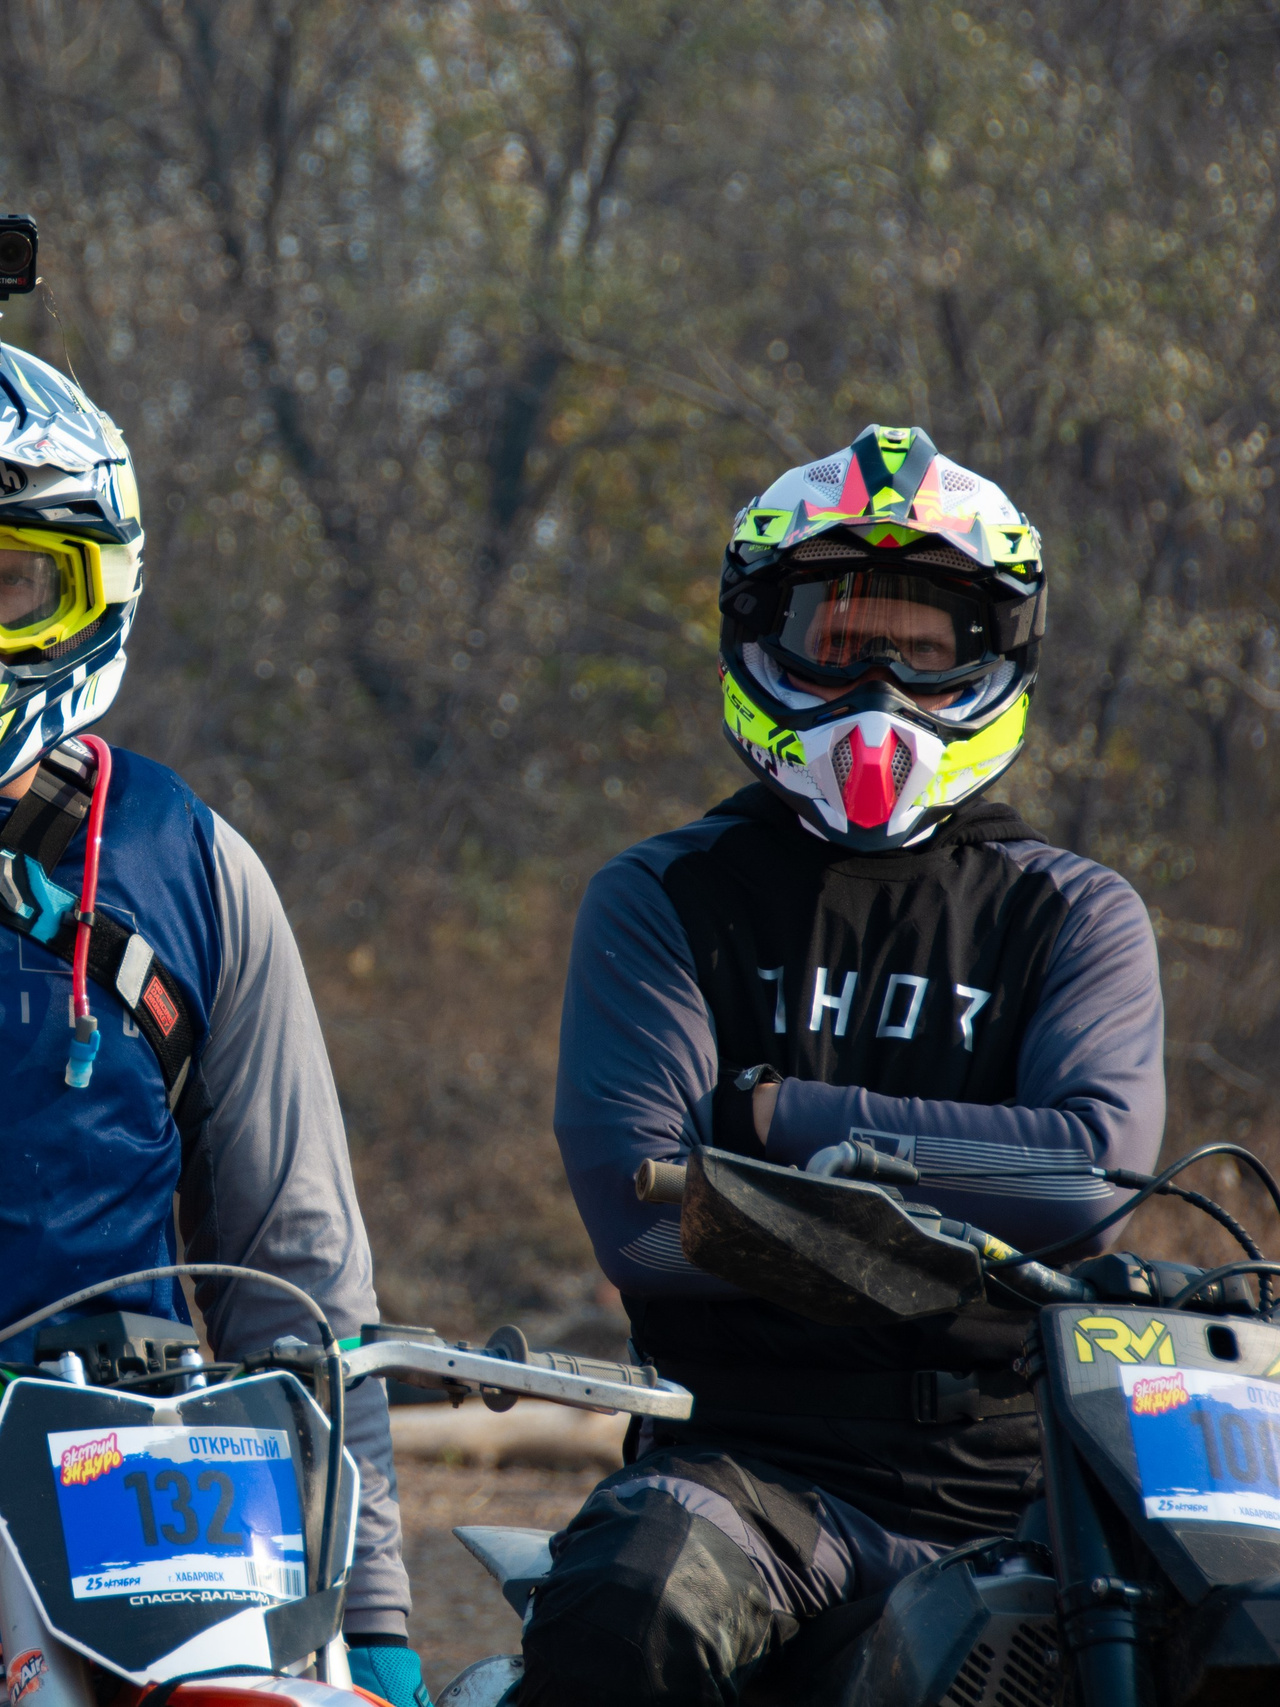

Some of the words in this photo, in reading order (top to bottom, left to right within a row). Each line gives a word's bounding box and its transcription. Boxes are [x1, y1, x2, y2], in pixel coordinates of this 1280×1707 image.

[726, 684, 755, 723] LS2
[1135, 1374, 1184, 1398] ЭКСТРИМ
[1134, 1388, 1188, 1413] ЭНДУРО
[63, 1433, 116, 1468] ЭКСТРИМ
[188, 1436, 281, 1459] ОТКРЫТЫЙ
[63, 1450, 121, 1484] ЭНДУРО
[123, 1469, 244, 1547] 132
[1157, 1499, 1174, 1512] 25
[85, 1577, 103, 1591] 25
[175, 1571, 225, 1583] ХАБАРОВСК
